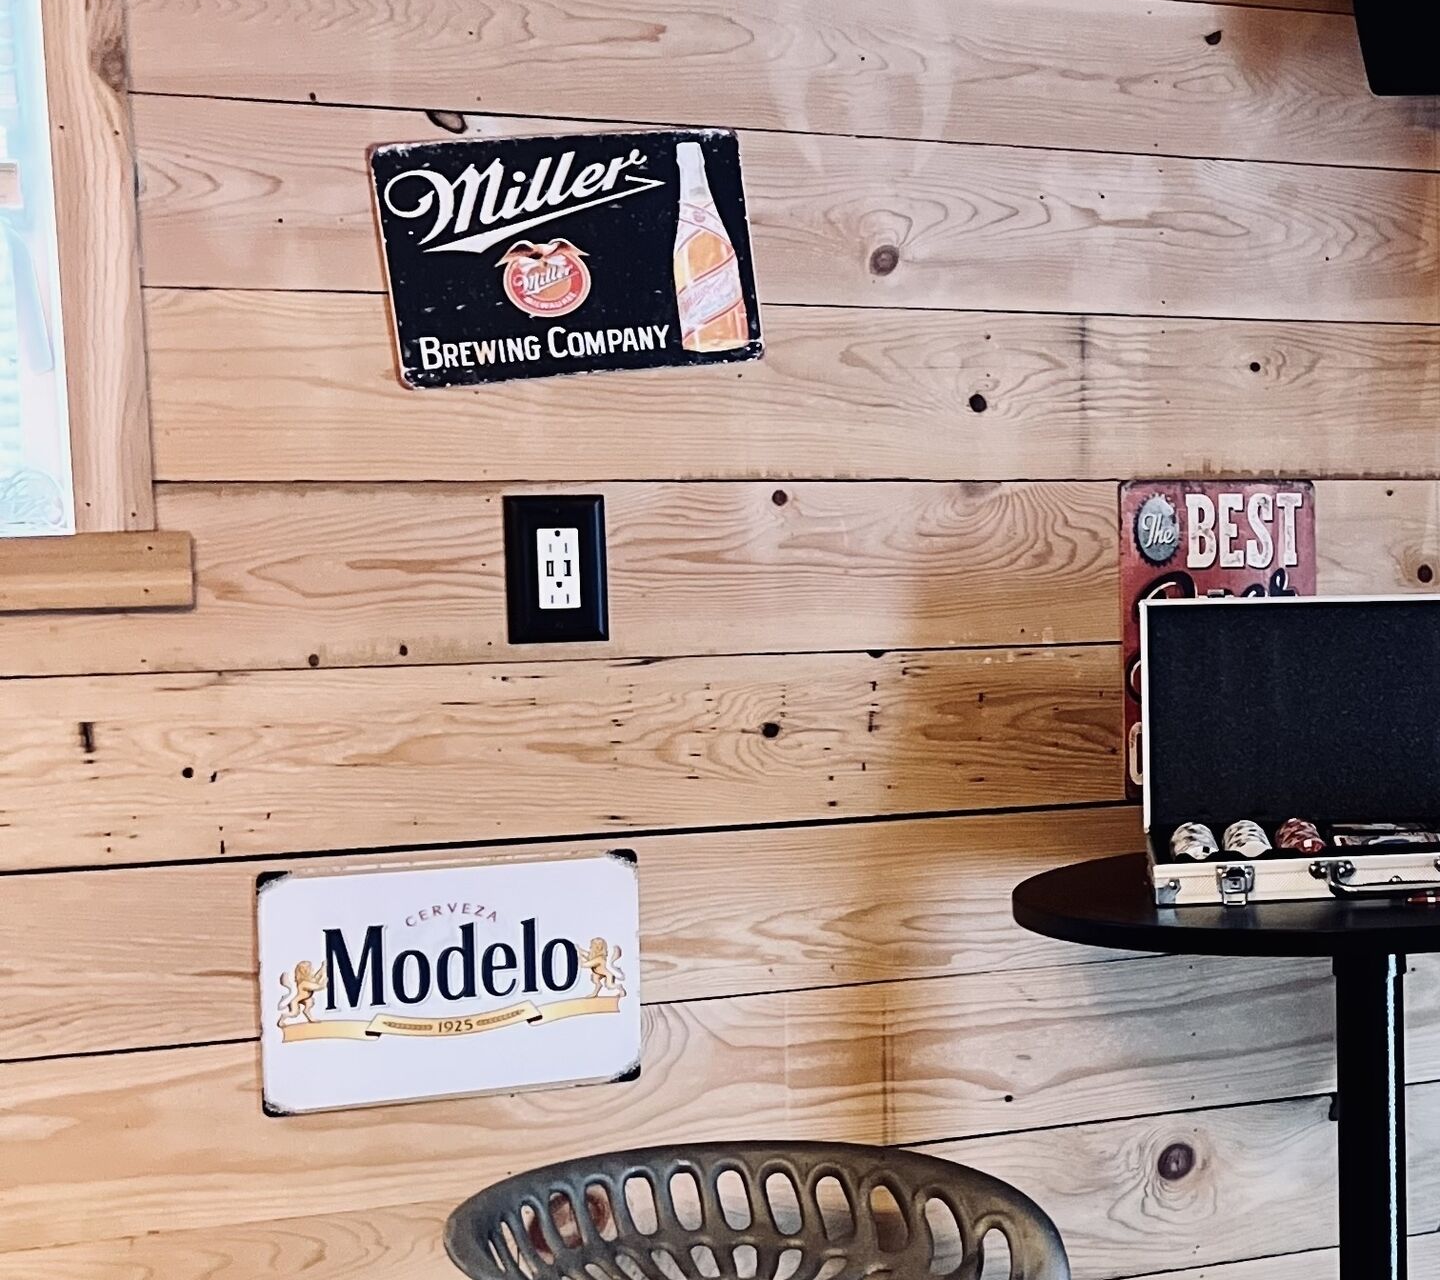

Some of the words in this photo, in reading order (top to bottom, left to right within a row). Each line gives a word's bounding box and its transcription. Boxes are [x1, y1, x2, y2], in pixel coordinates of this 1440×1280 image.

[384, 148, 650, 247] Miller
[512, 263, 580, 297] Miller
[1142, 513, 1176, 548] The
[1185, 492, 1303, 569] BEST
[404, 902, 498, 927] CERVEZA
[322, 917, 579, 1011] Modelo
[437, 1018, 474, 1034] 1925
